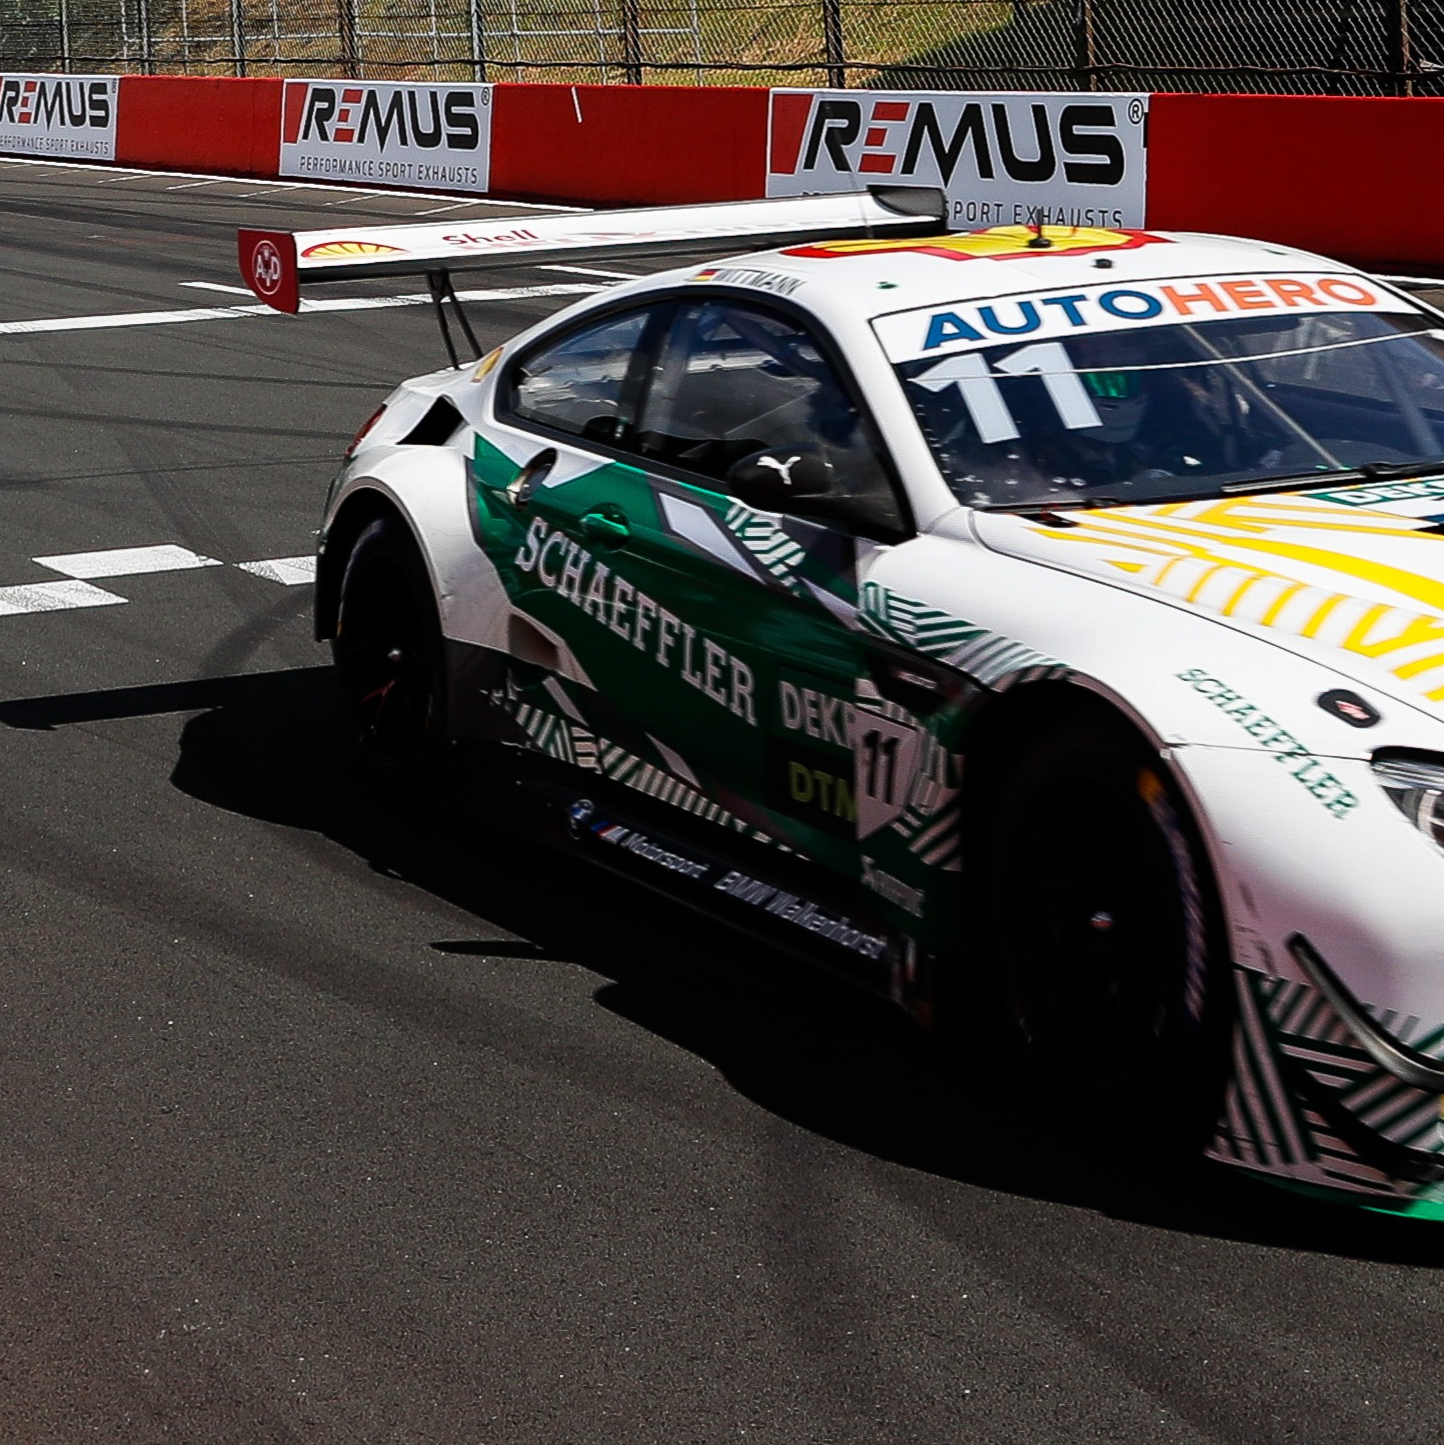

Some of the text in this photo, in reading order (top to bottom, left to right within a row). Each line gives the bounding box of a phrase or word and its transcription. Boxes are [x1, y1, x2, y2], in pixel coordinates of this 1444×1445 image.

[302, 87, 479, 154] REMUS
[802, 99, 1125, 189] REMUS
[299, 155, 478, 185] PERFORMANCE SPORT EXHAUSTS
[442, 228, 540, 246] Shell
[945, 199, 1123, 230] PORT EXHAUSTS
[921, 278, 1377, 351] AUTOHERO
[910, 341, 1104, 444] 11
[514, 515, 759, 727] SCHAEFFLER
[863, 729, 899, 805] 11
[1174, 667, 1360, 821] SCHAEFFLER
